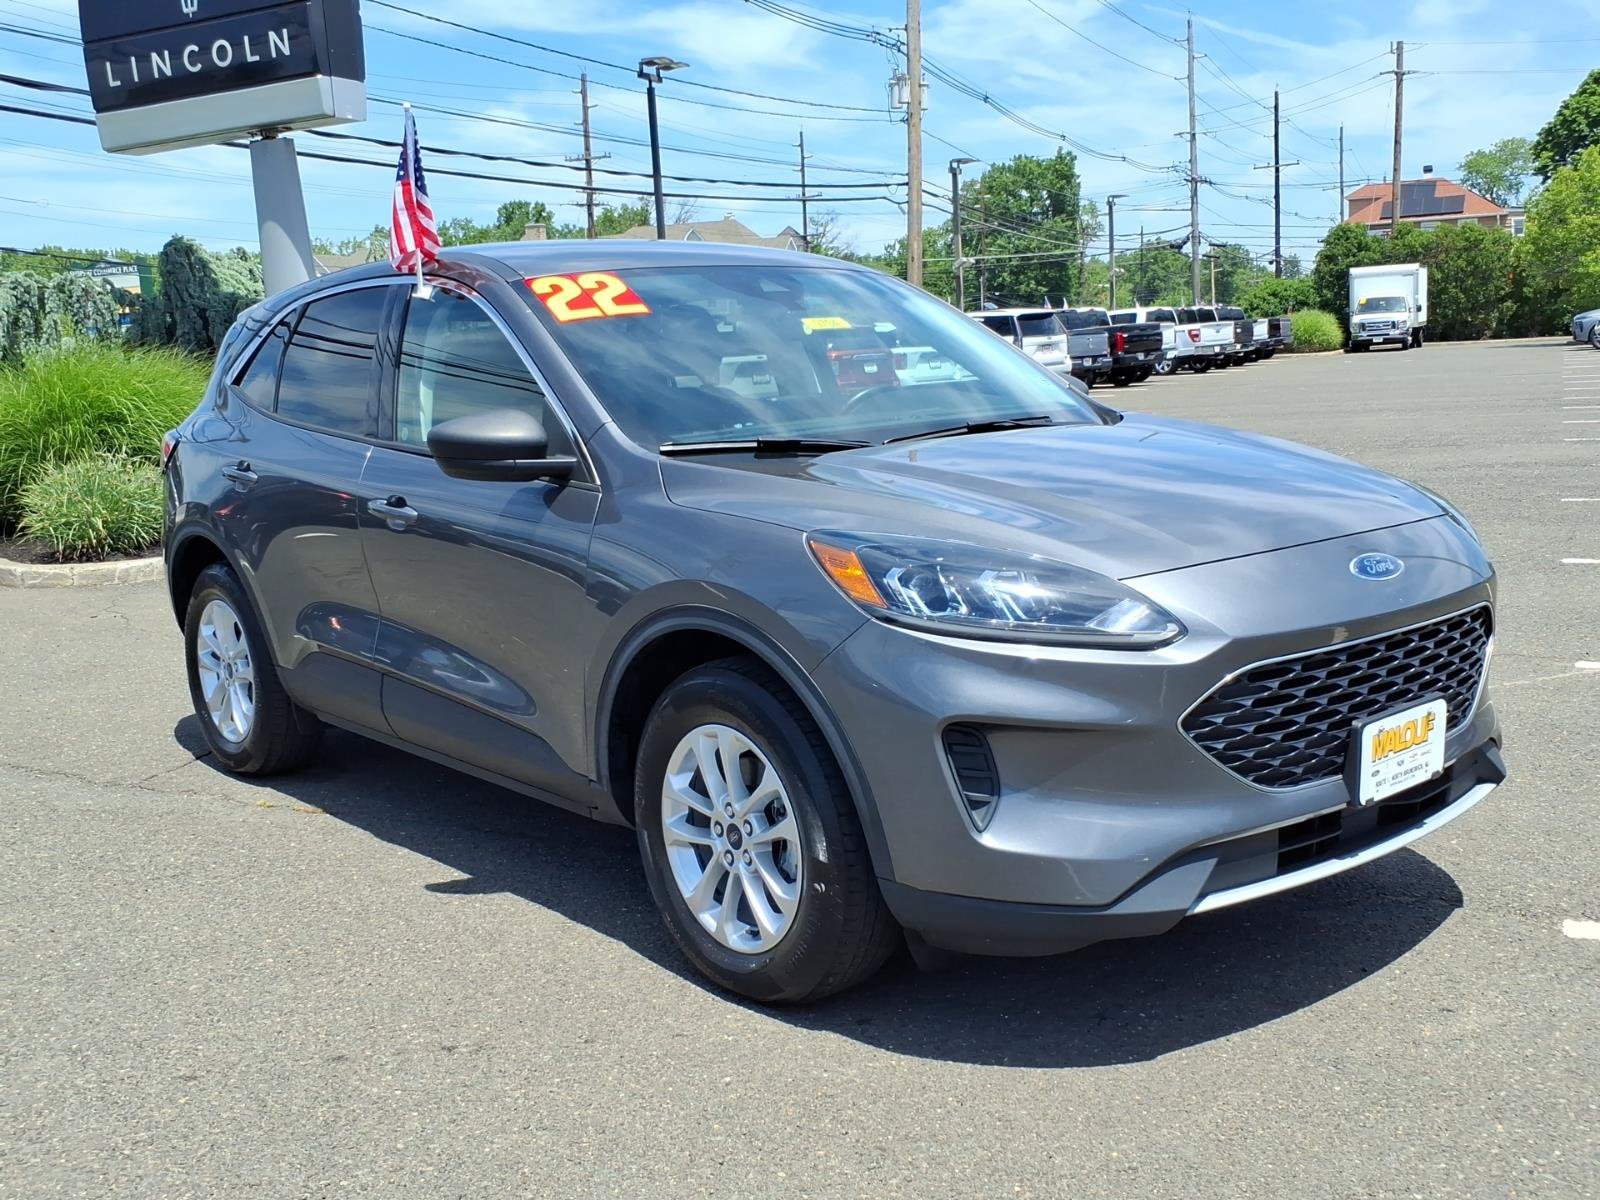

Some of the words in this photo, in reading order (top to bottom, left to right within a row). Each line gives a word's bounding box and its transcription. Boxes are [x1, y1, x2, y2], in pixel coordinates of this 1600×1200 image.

[105, 28, 291, 88] LINCOLN
[123, 265, 138, 273] PLACE
[531, 273, 649, 321] 22
[1363, 557, 1394, 574] Ford
[1372, 711, 1436, 763] MALOUF
